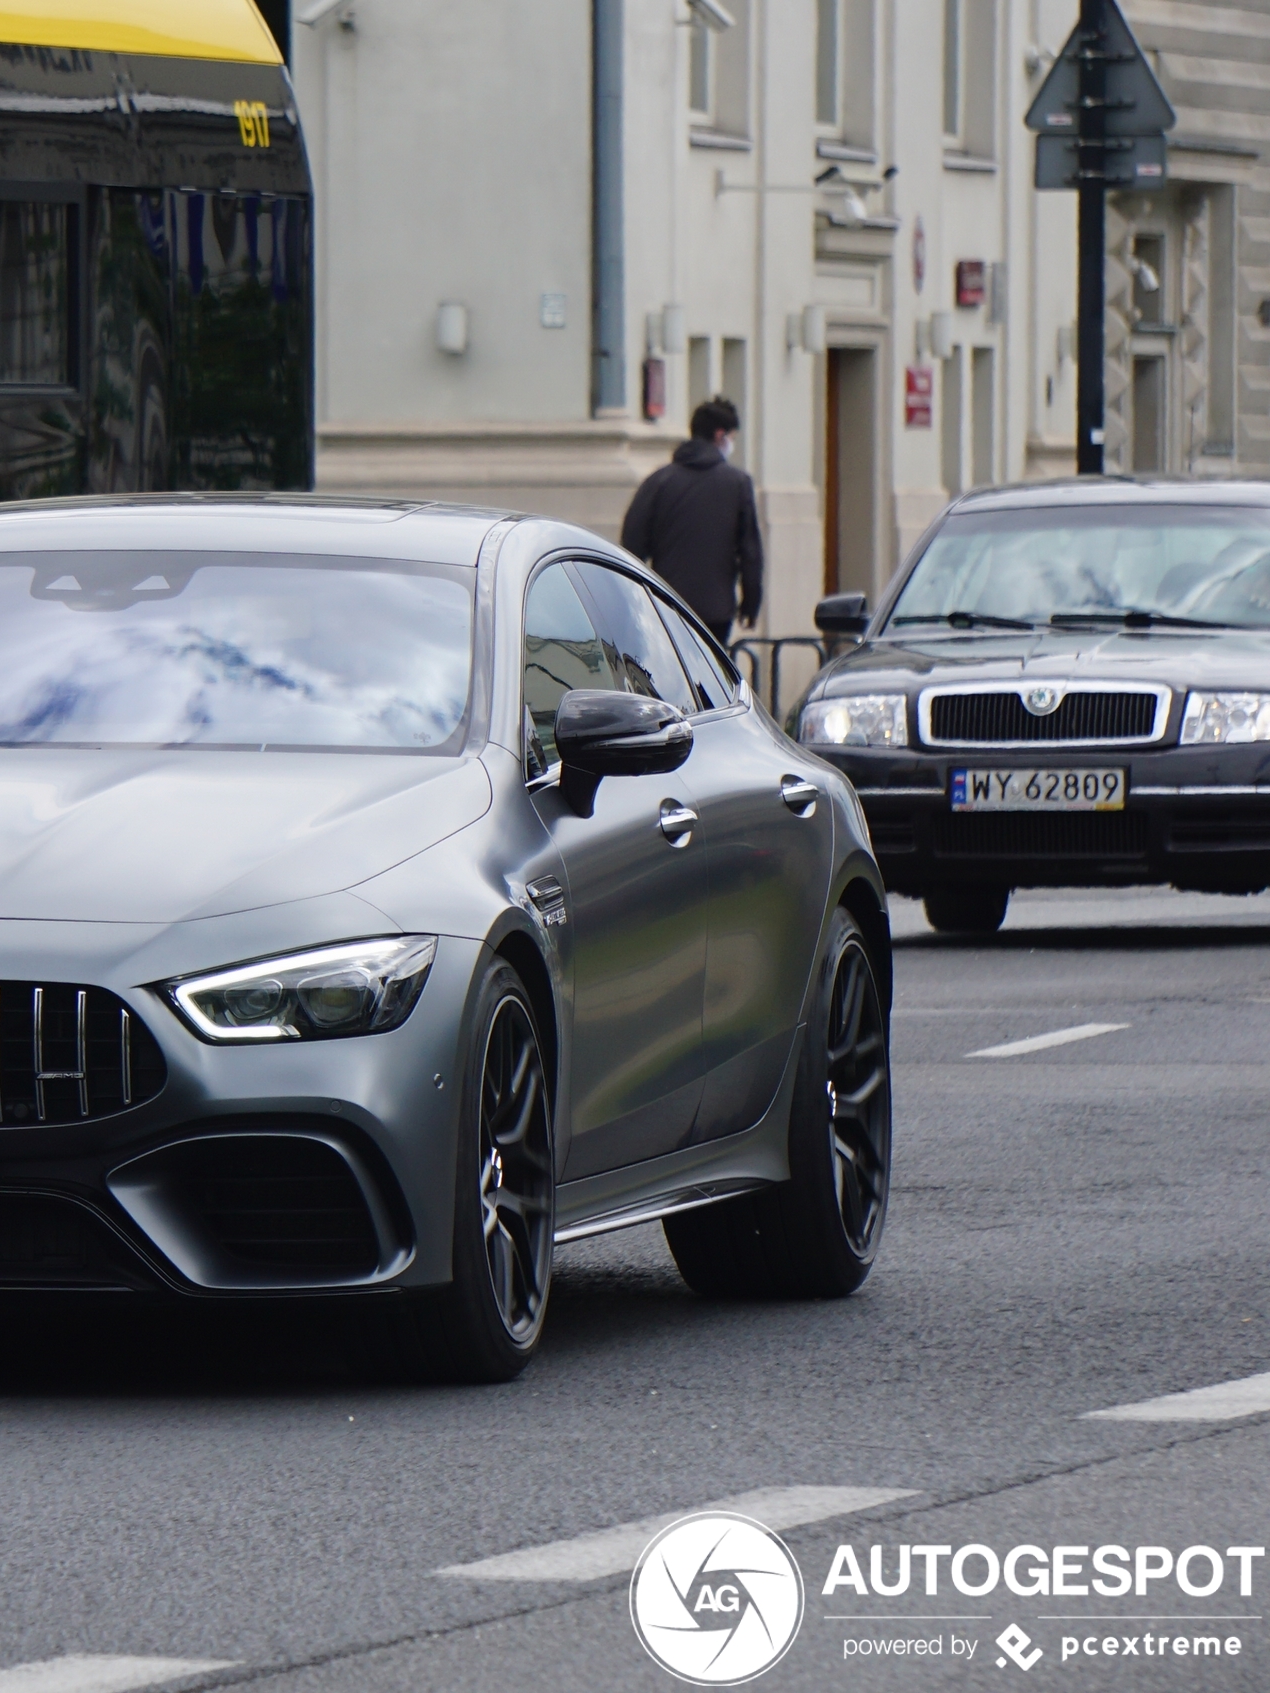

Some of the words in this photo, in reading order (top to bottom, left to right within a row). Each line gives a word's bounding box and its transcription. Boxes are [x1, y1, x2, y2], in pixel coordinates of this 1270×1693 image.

[234, 101, 270, 148] 1917
[972, 773, 1013, 801] WY
[1026, 773, 1119, 801] 62809
